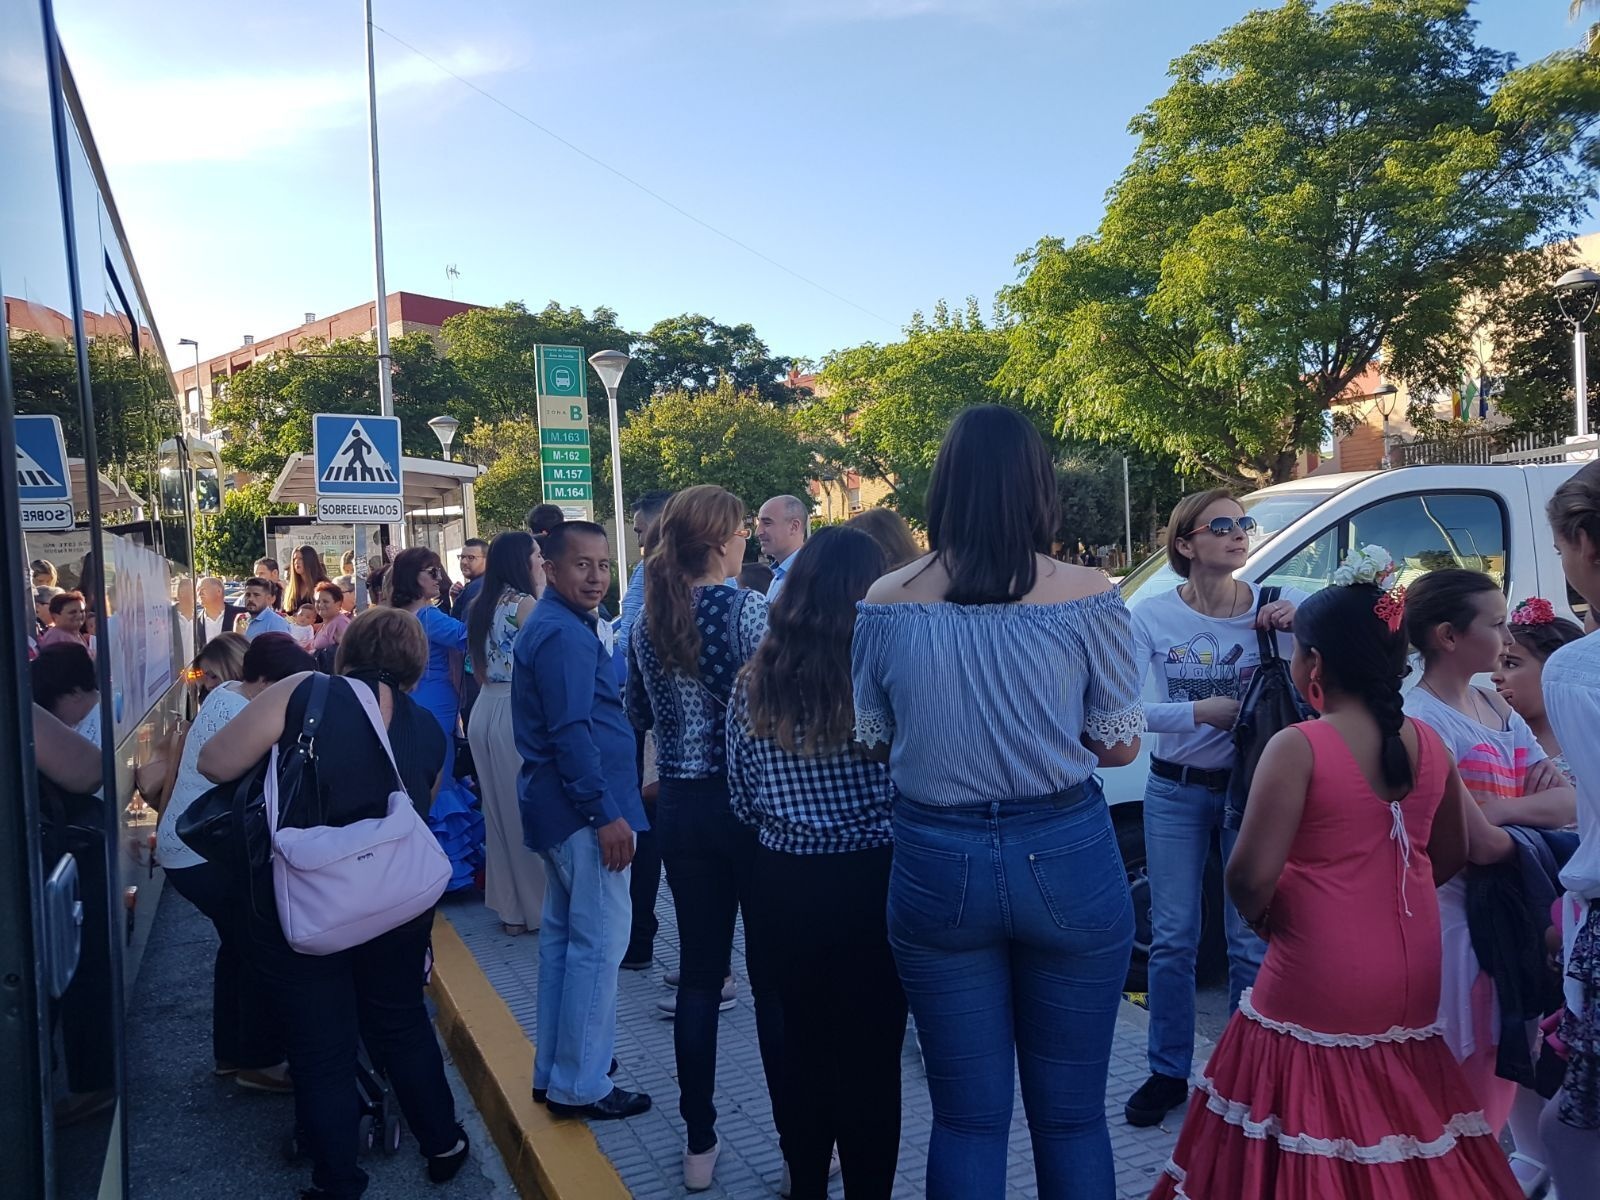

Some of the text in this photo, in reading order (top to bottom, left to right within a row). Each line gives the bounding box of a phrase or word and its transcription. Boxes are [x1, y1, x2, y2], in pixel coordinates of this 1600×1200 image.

[570, 405, 583, 421] B
[550, 431, 580, 442] M.163
[552, 451, 580, 461] M-162
[554, 469, 583, 479] M.157
[555, 487, 585, 498] M.164
[322, 504, 398, 516] SOBREELEVADOS
